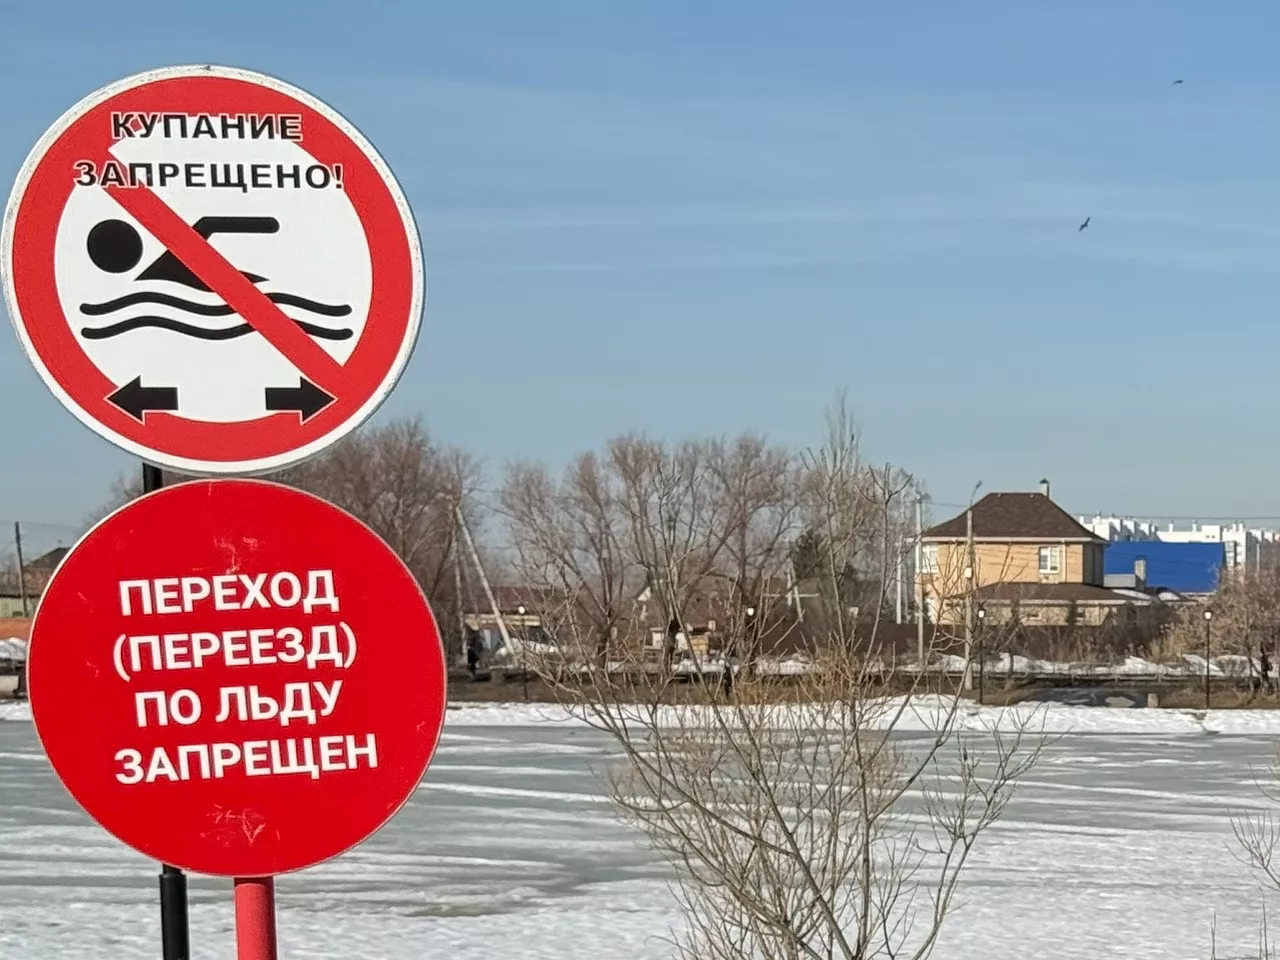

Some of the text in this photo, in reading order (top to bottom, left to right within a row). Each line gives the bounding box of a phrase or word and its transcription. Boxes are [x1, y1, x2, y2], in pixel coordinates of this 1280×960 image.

[112, 113, 303, 141] КУПАНИЕ
[74, 161, 344, 193] ЗАПРЕЩЕНО!
[118, 569, 340, 616] ПЕРЕХОД
[113, 621, 358, 682] (ПЕРЕЕЗД)
[135, 680, 343, 727] ПО ЛЬДУ
[114, 733, 379, 785] ЗАПРЕЩЕН
